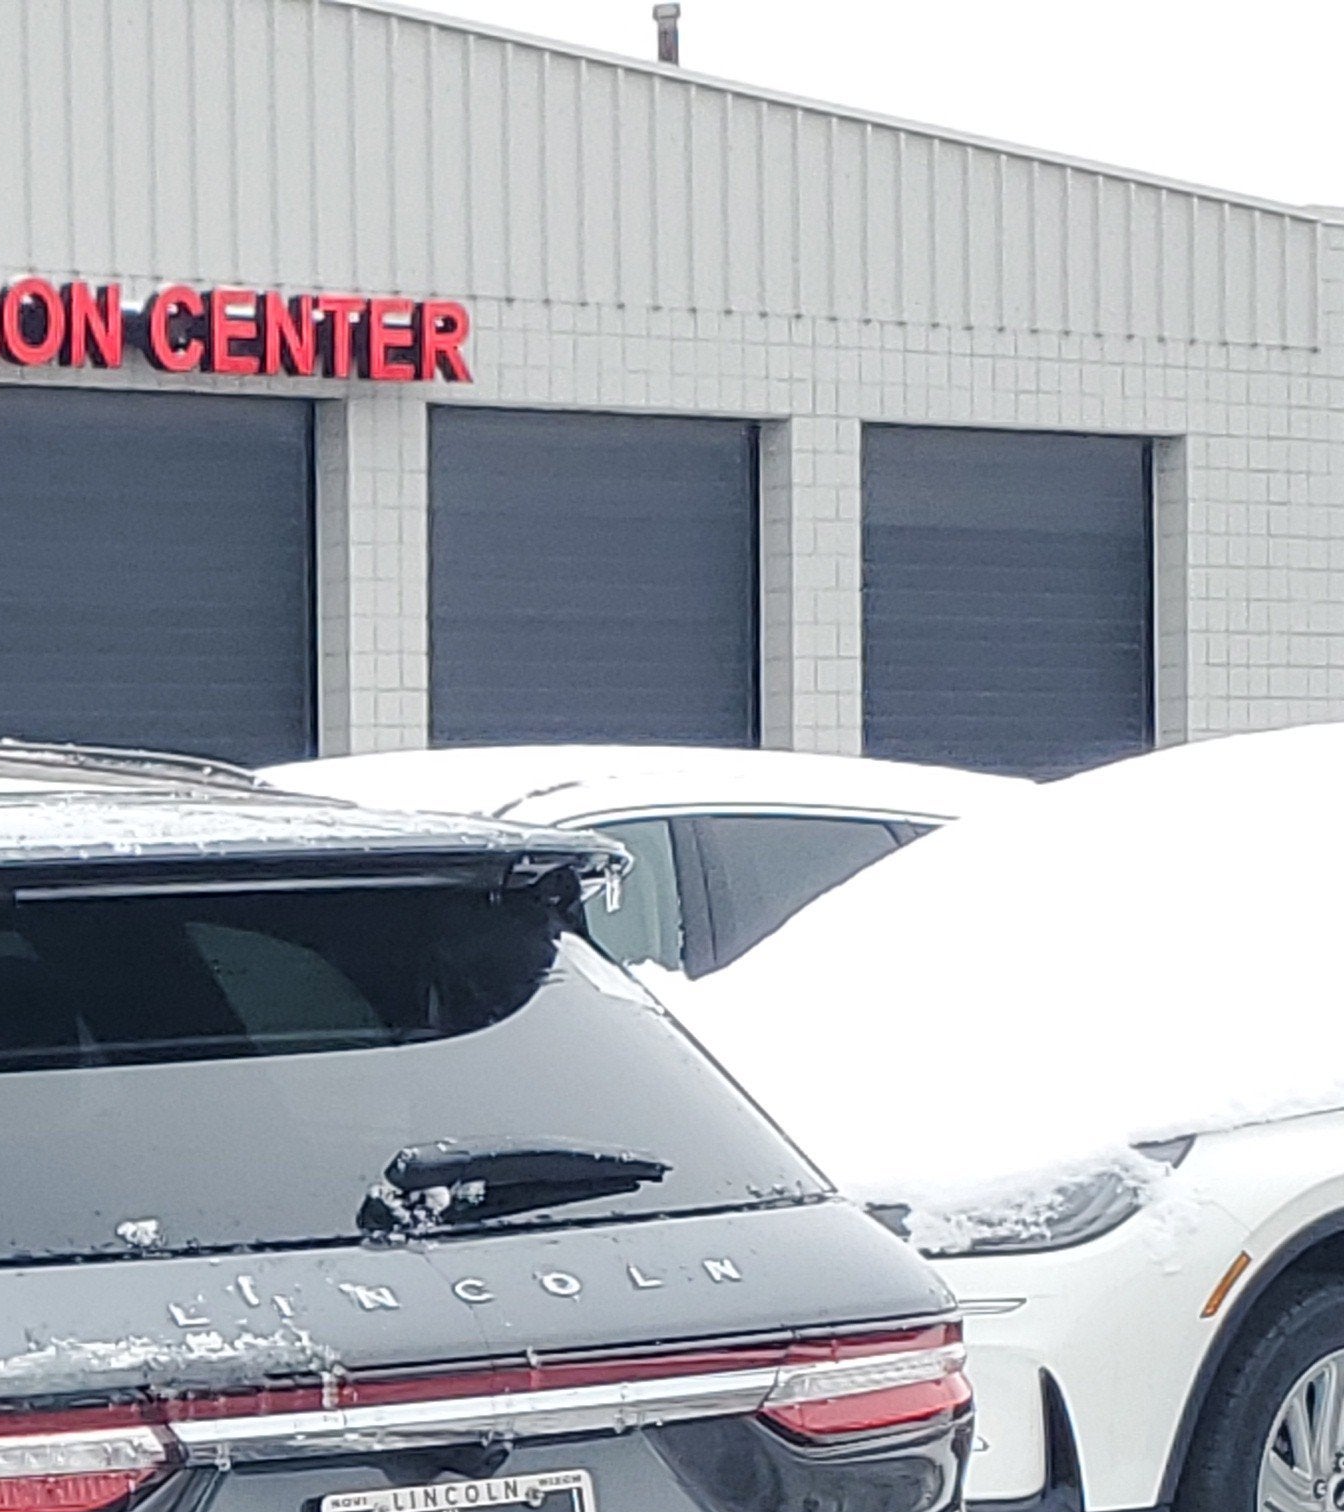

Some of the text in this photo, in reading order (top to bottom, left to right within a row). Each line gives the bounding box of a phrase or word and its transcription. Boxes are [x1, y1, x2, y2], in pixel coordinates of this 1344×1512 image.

[148, 285, 472, 384] CENTER
[168, 1257, 742, 1328] LINCOLN
[393, 1480, 519, 1512] LINCOLN
